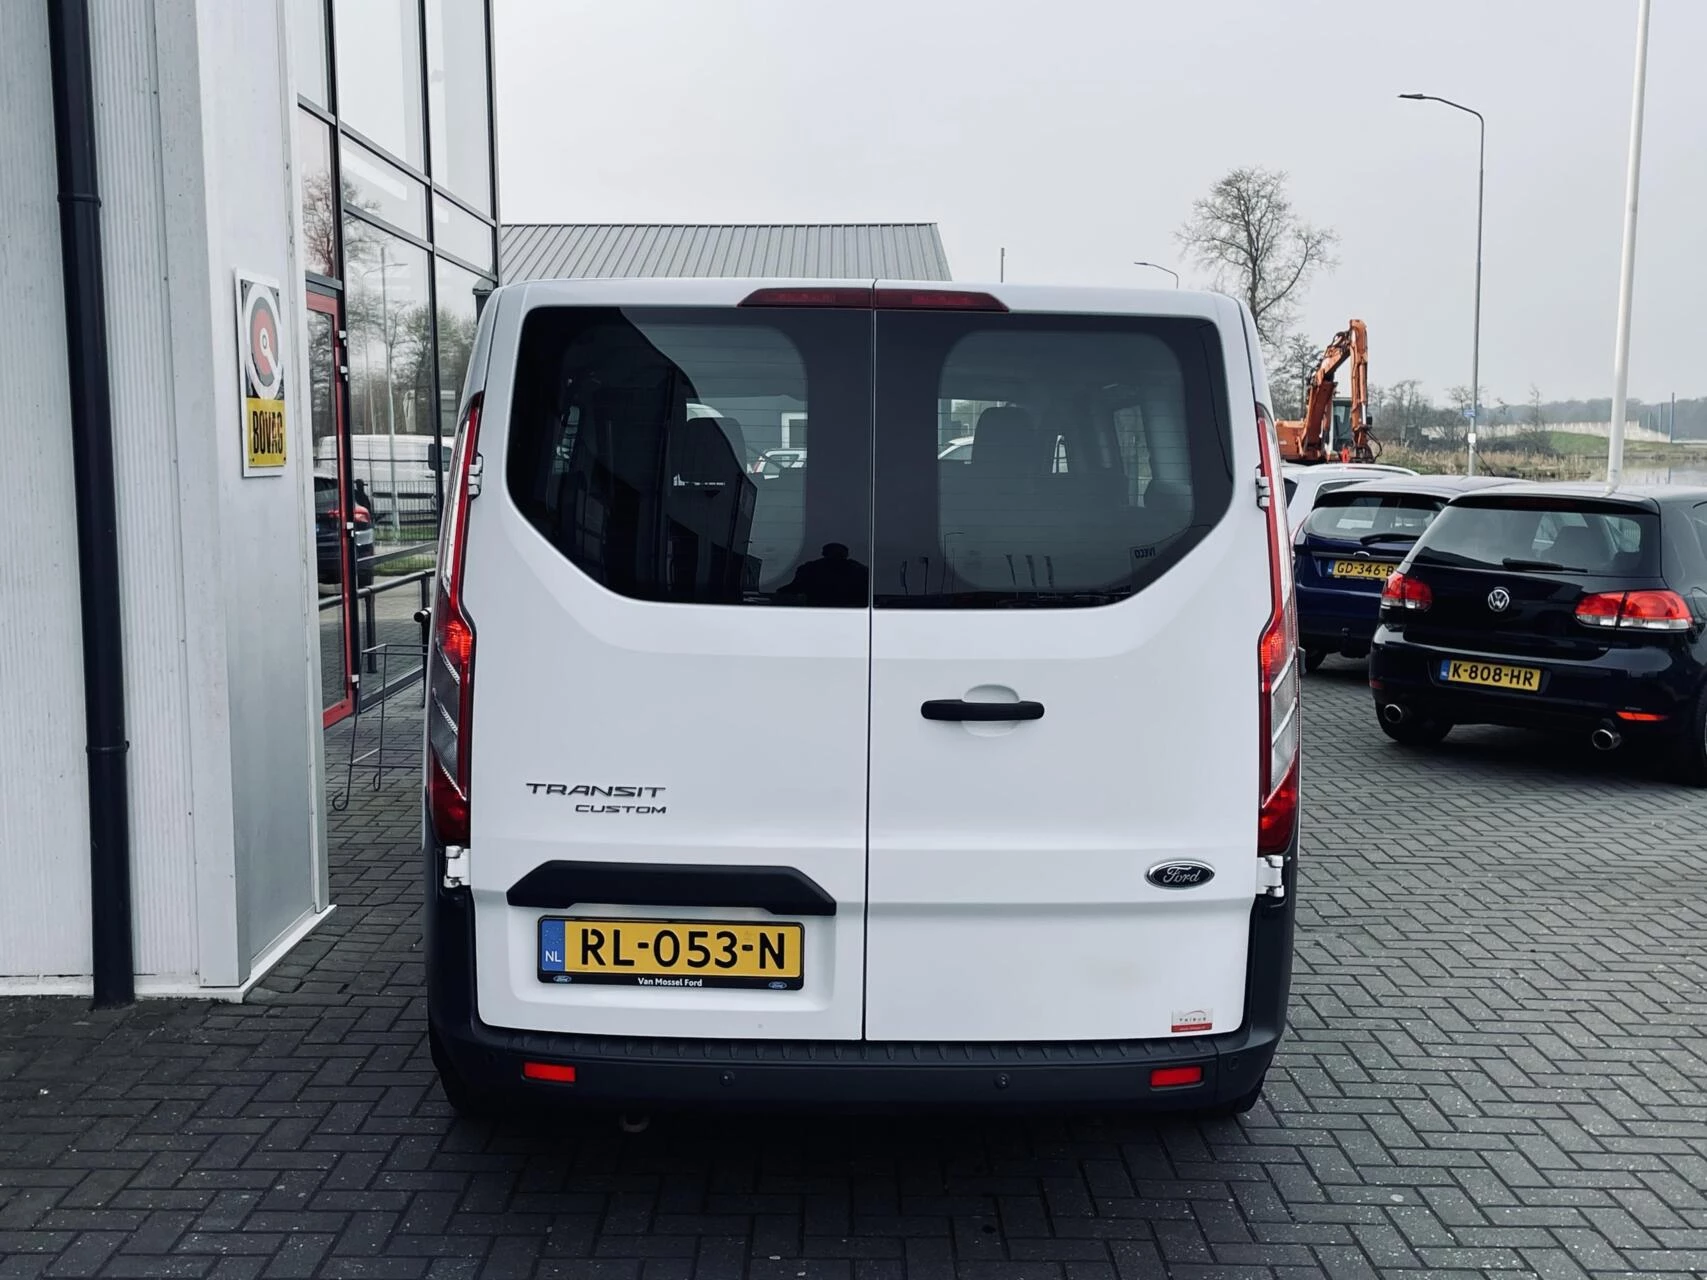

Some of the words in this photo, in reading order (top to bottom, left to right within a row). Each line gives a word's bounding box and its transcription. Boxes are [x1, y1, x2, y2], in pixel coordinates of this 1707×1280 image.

[1337, 562, 1394, 576] GD-346-B
[1452, 663, 1534, 686] K-808-HR
[526, 783, 666, 798] TRANSIT
[575, 804, 666, 814] CUSTOM
[1162, 866, 1201, 883] Ford
[545, 950, 562, 962] NL
[581, 928, 785, 970] RL-053-N
[638, 977, 653, 985] Van
[655, 977, 682, 986] Mossel
[684, 978, 702, 987] Ford
